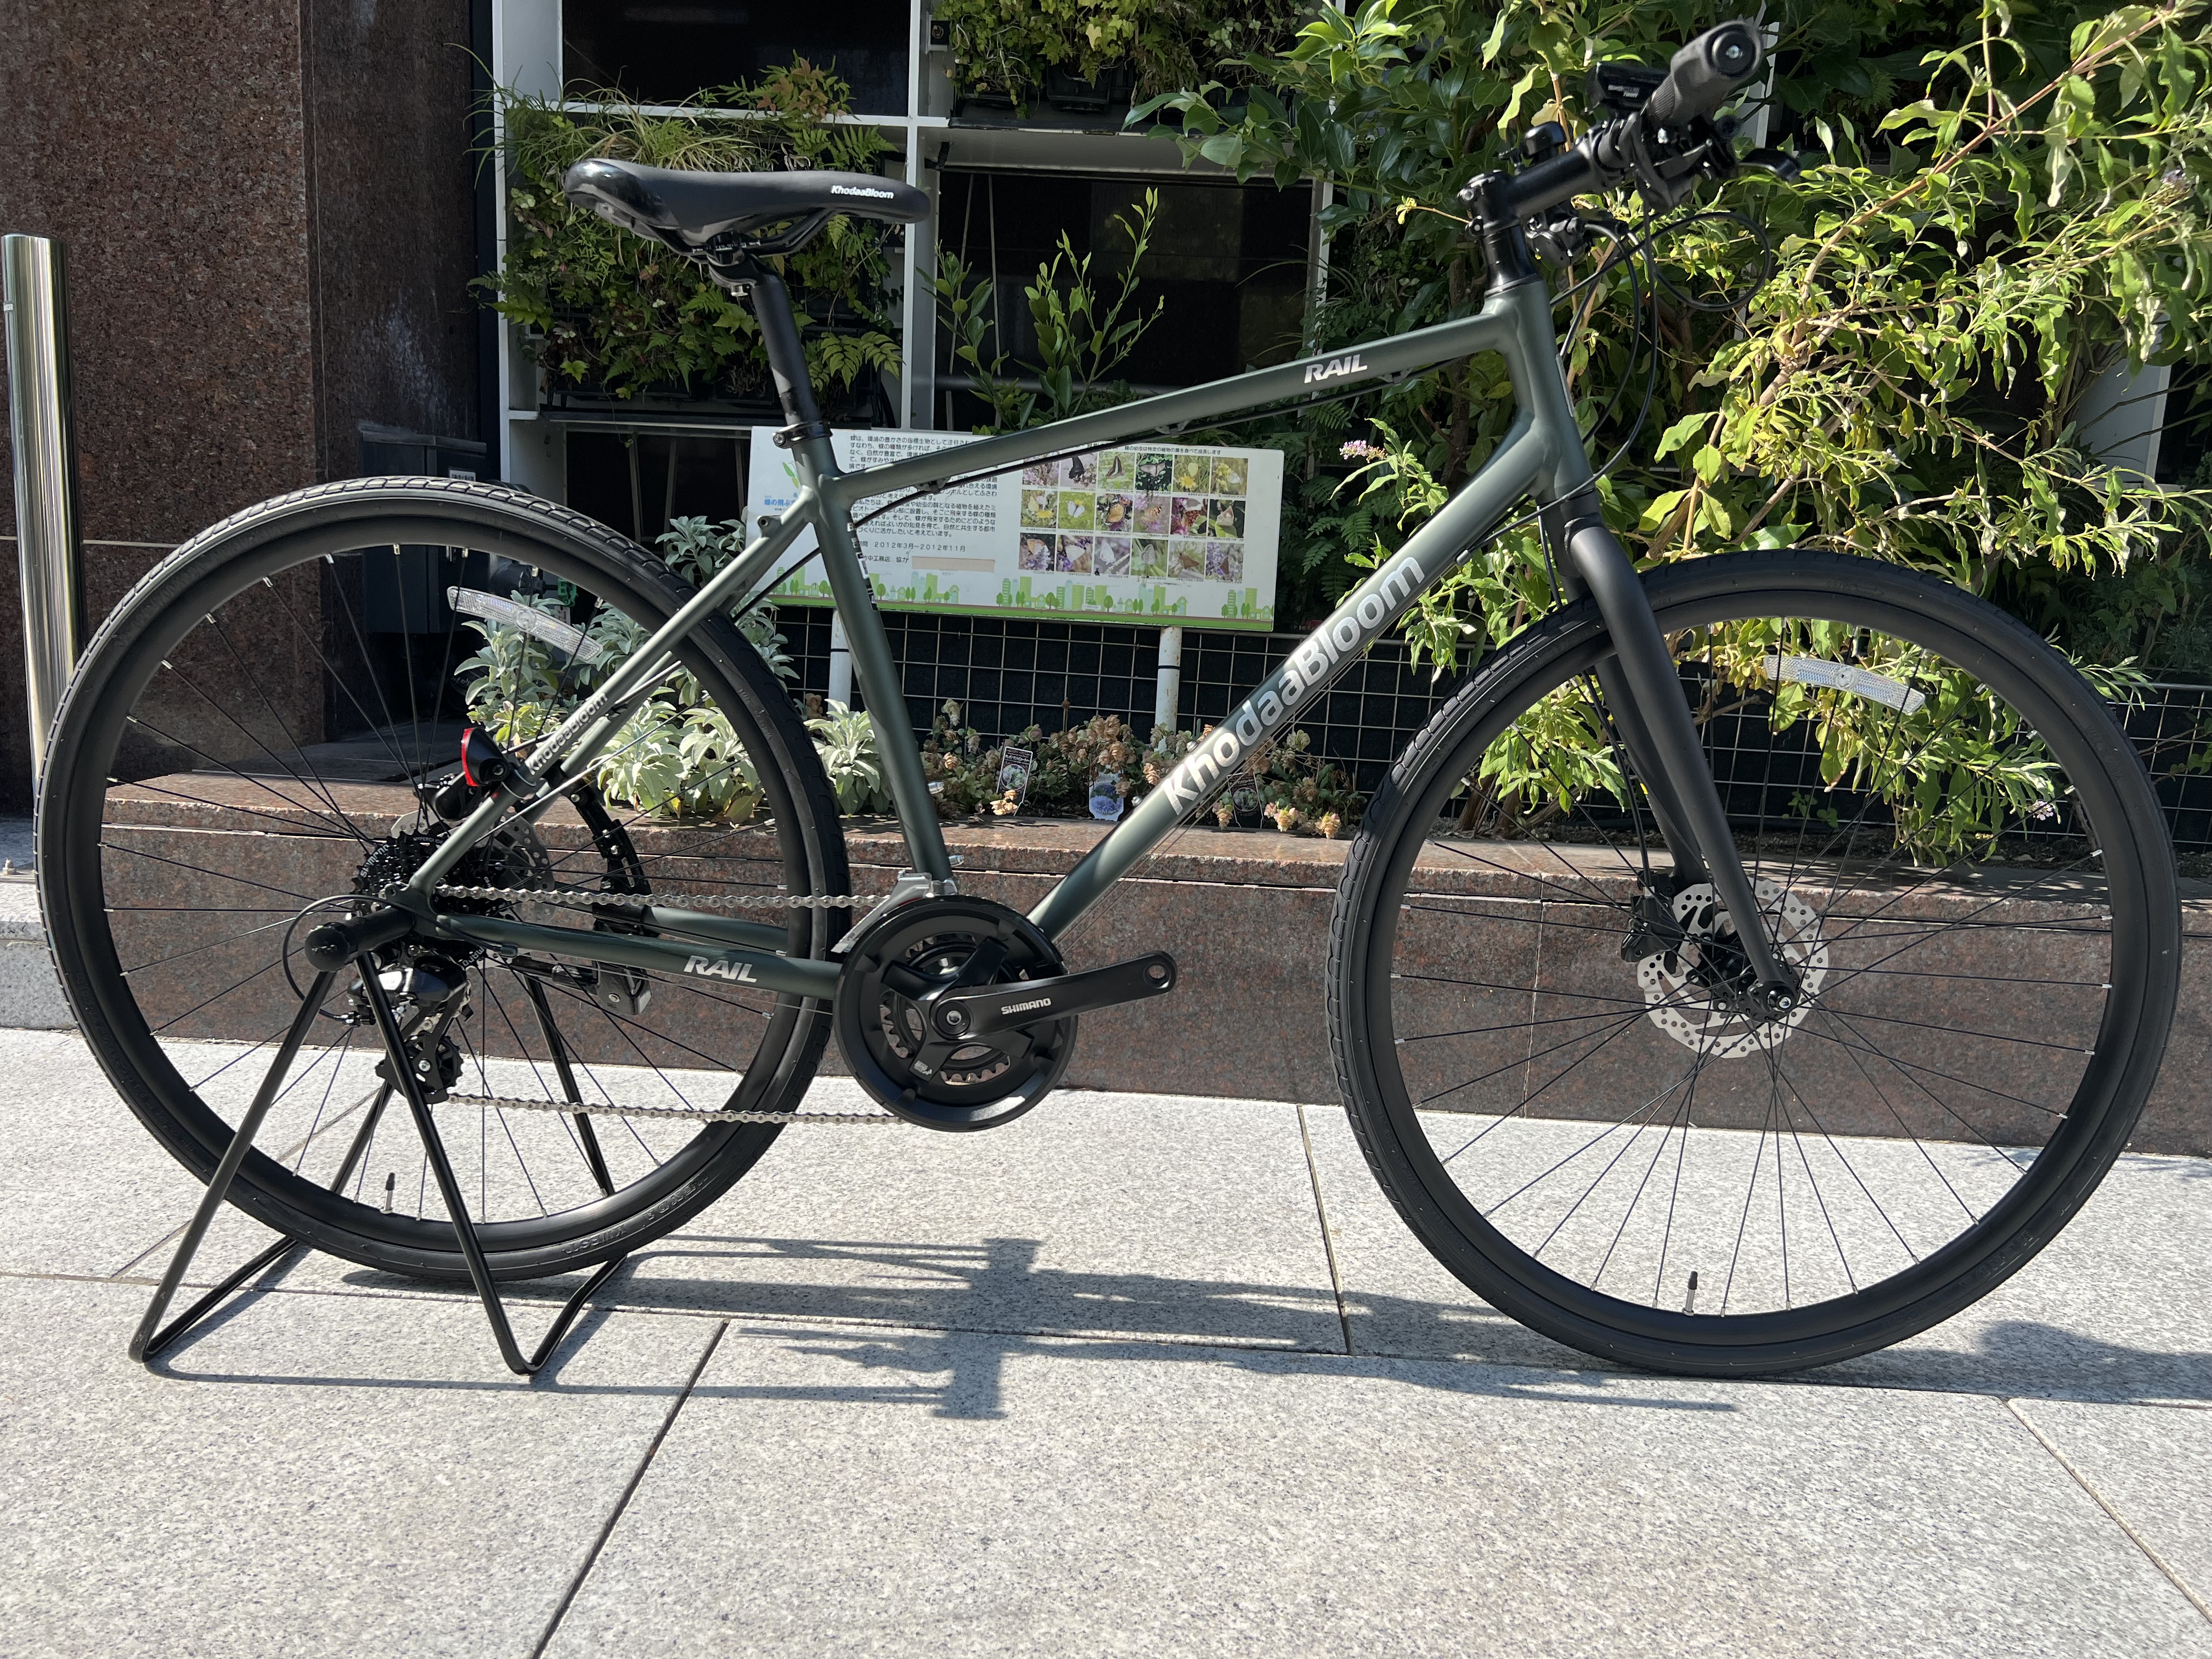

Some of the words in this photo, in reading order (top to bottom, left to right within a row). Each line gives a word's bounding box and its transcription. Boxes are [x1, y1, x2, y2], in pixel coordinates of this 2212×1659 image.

[831, 185, 894, 199] KhodaaBloom
[1304, 354, 1368, 383] RAIL
[1160, 556, 1425, 816] KhodaaBloom
[684, 955, 758, 983] RAIL
[1001, 997, 1052, 1015] SHIMANO
